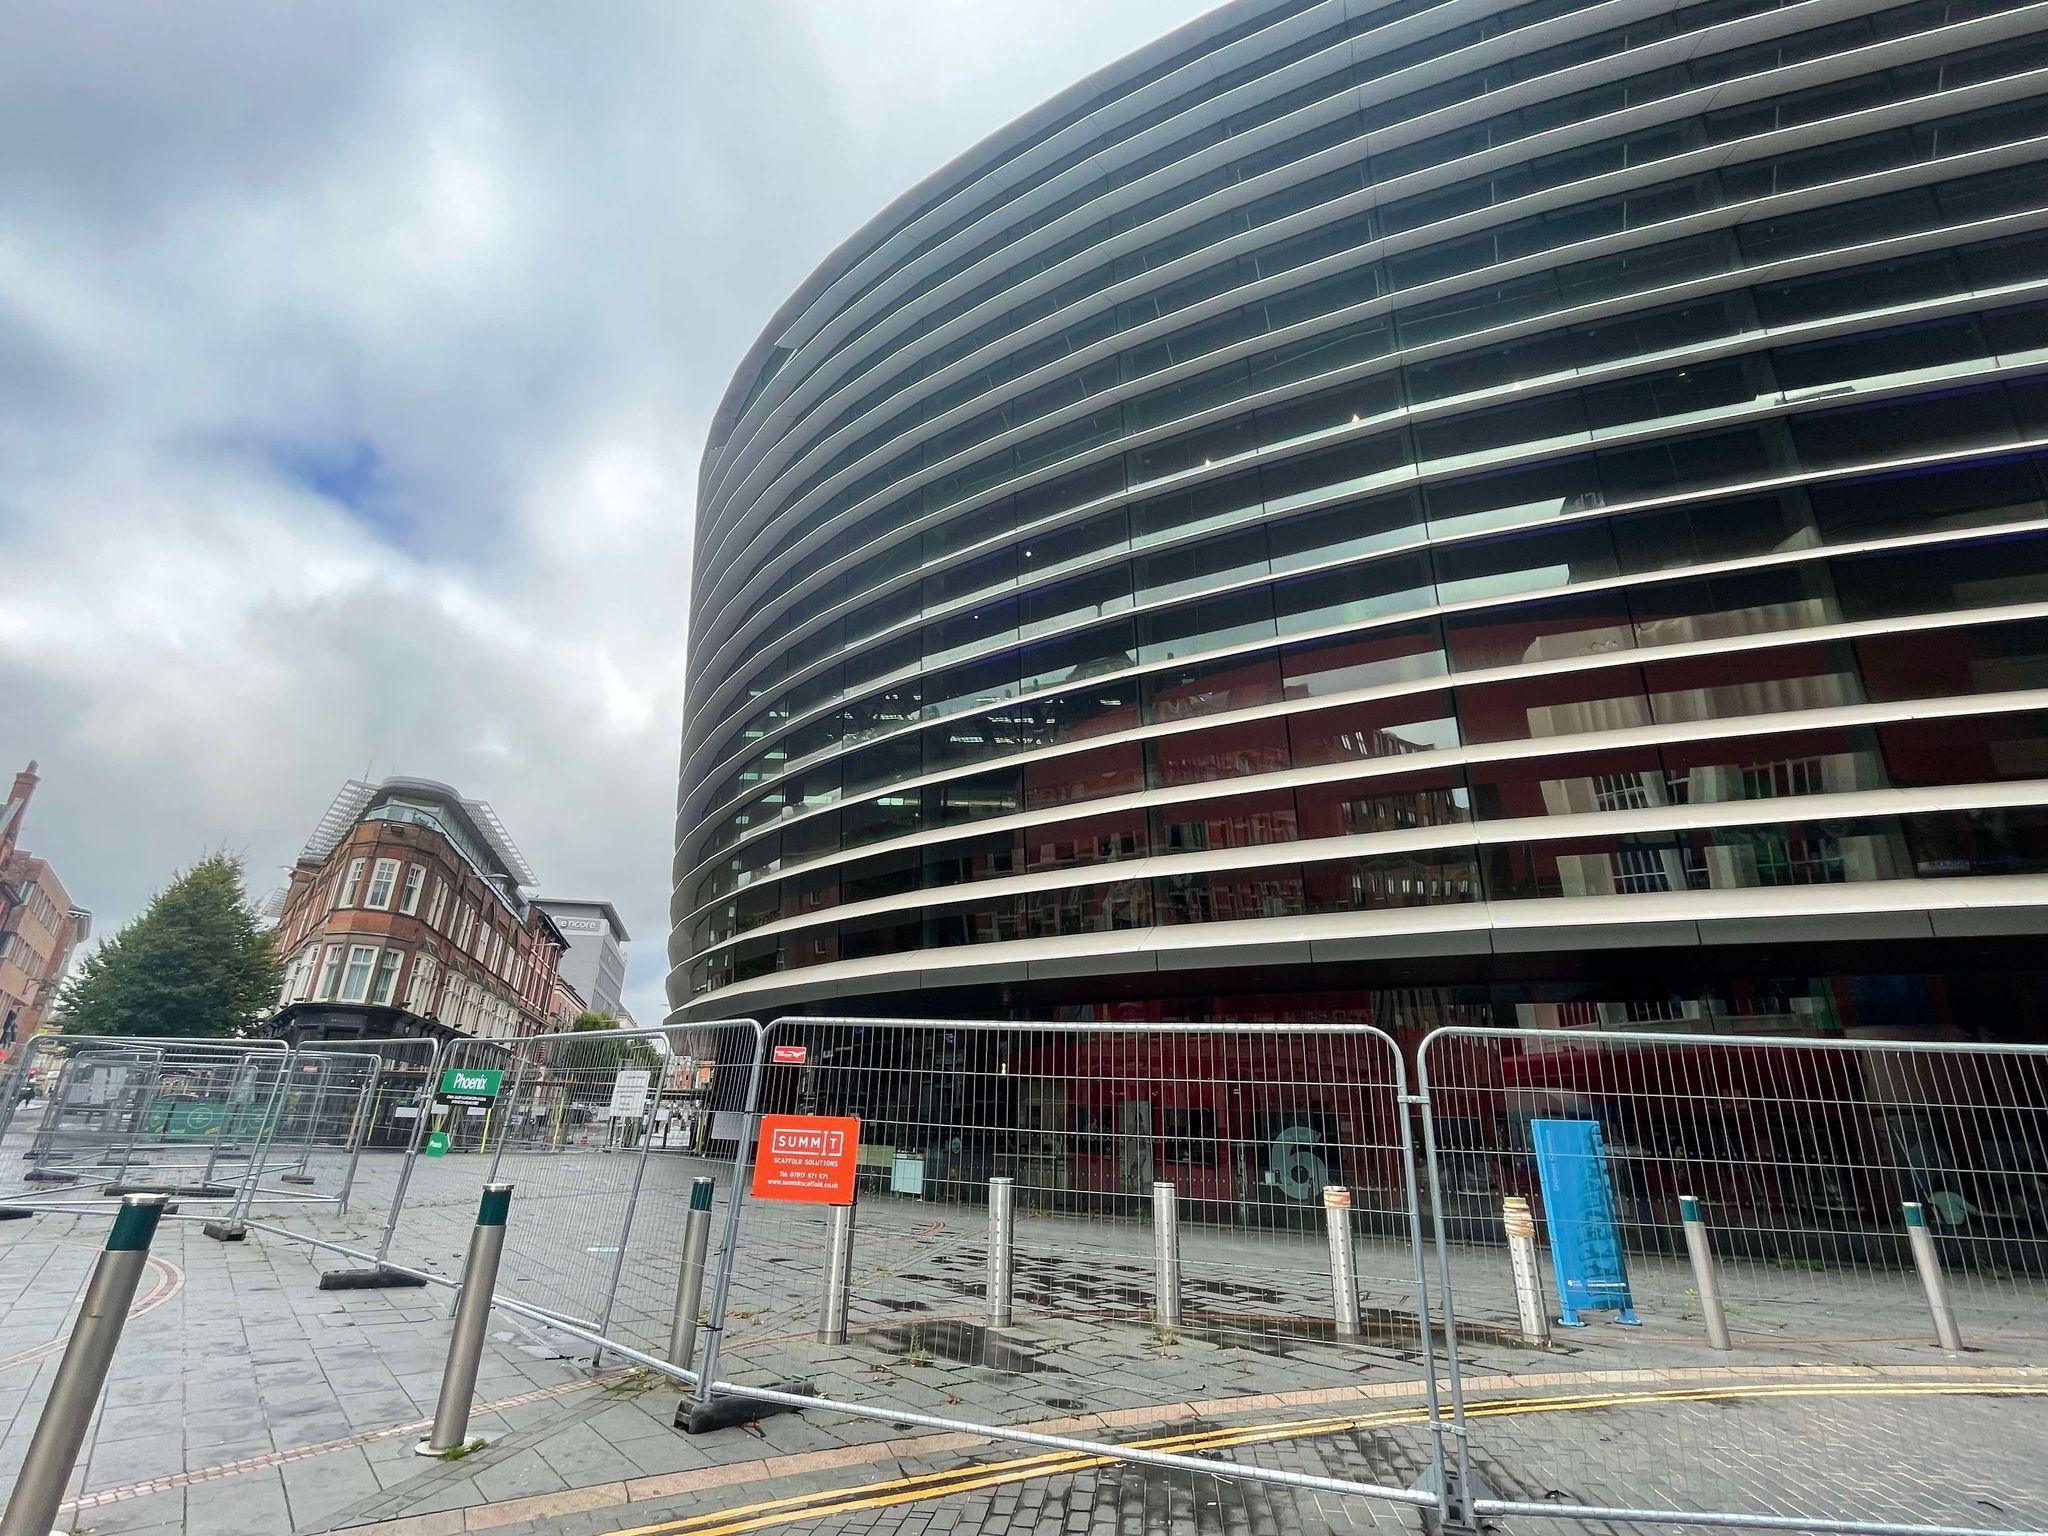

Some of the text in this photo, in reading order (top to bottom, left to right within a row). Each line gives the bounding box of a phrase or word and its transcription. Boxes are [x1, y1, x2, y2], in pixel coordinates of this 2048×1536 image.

[560, 920, 596, 929] encore
[453, 1072, 488, 1090] Phoenix
[778, 1131, 838, 1156] SUMMIT
[774, 1157, 838, 1167] SCAFFOLD SOLUTIONS
